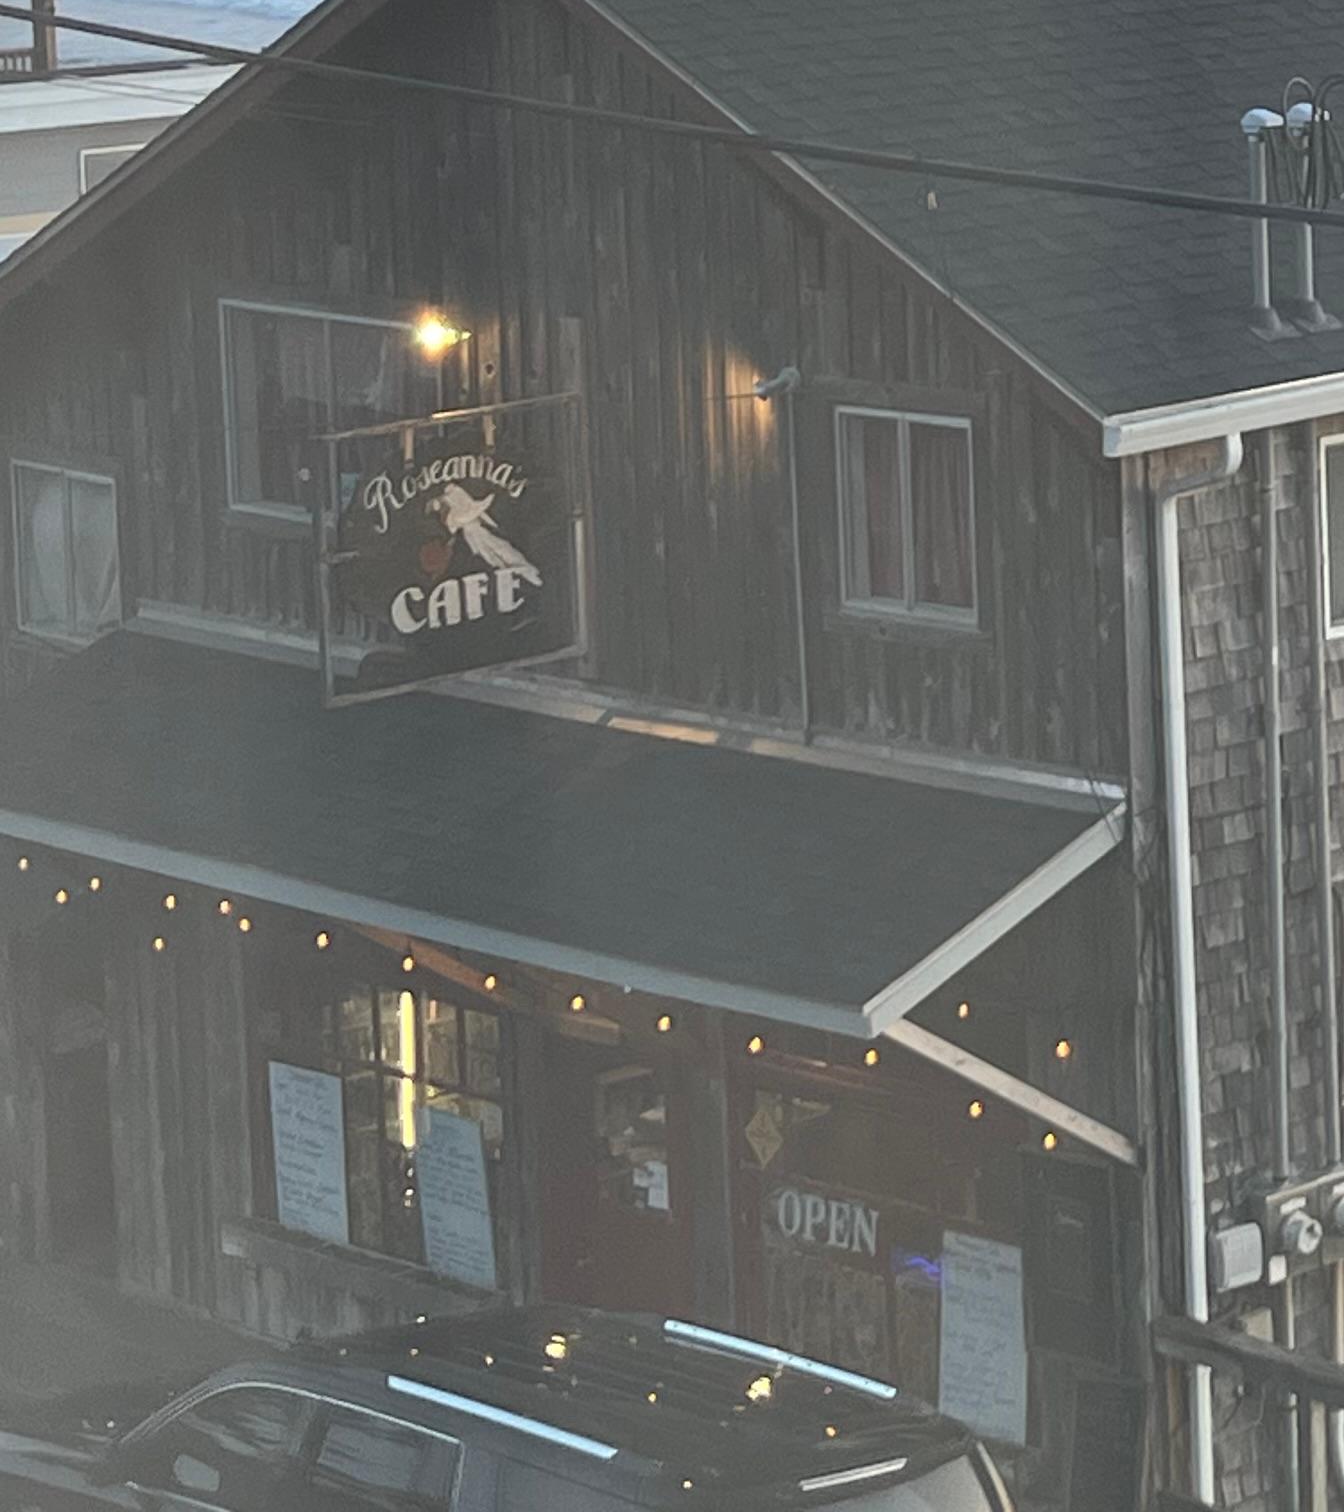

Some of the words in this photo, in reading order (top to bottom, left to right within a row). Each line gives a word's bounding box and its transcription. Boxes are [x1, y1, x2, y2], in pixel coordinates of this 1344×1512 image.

[364, 454, 528, 533] Roseanna's
[391, 567, 525, 633] CAFE
[777, 1190, 880, 1257] OPEN
